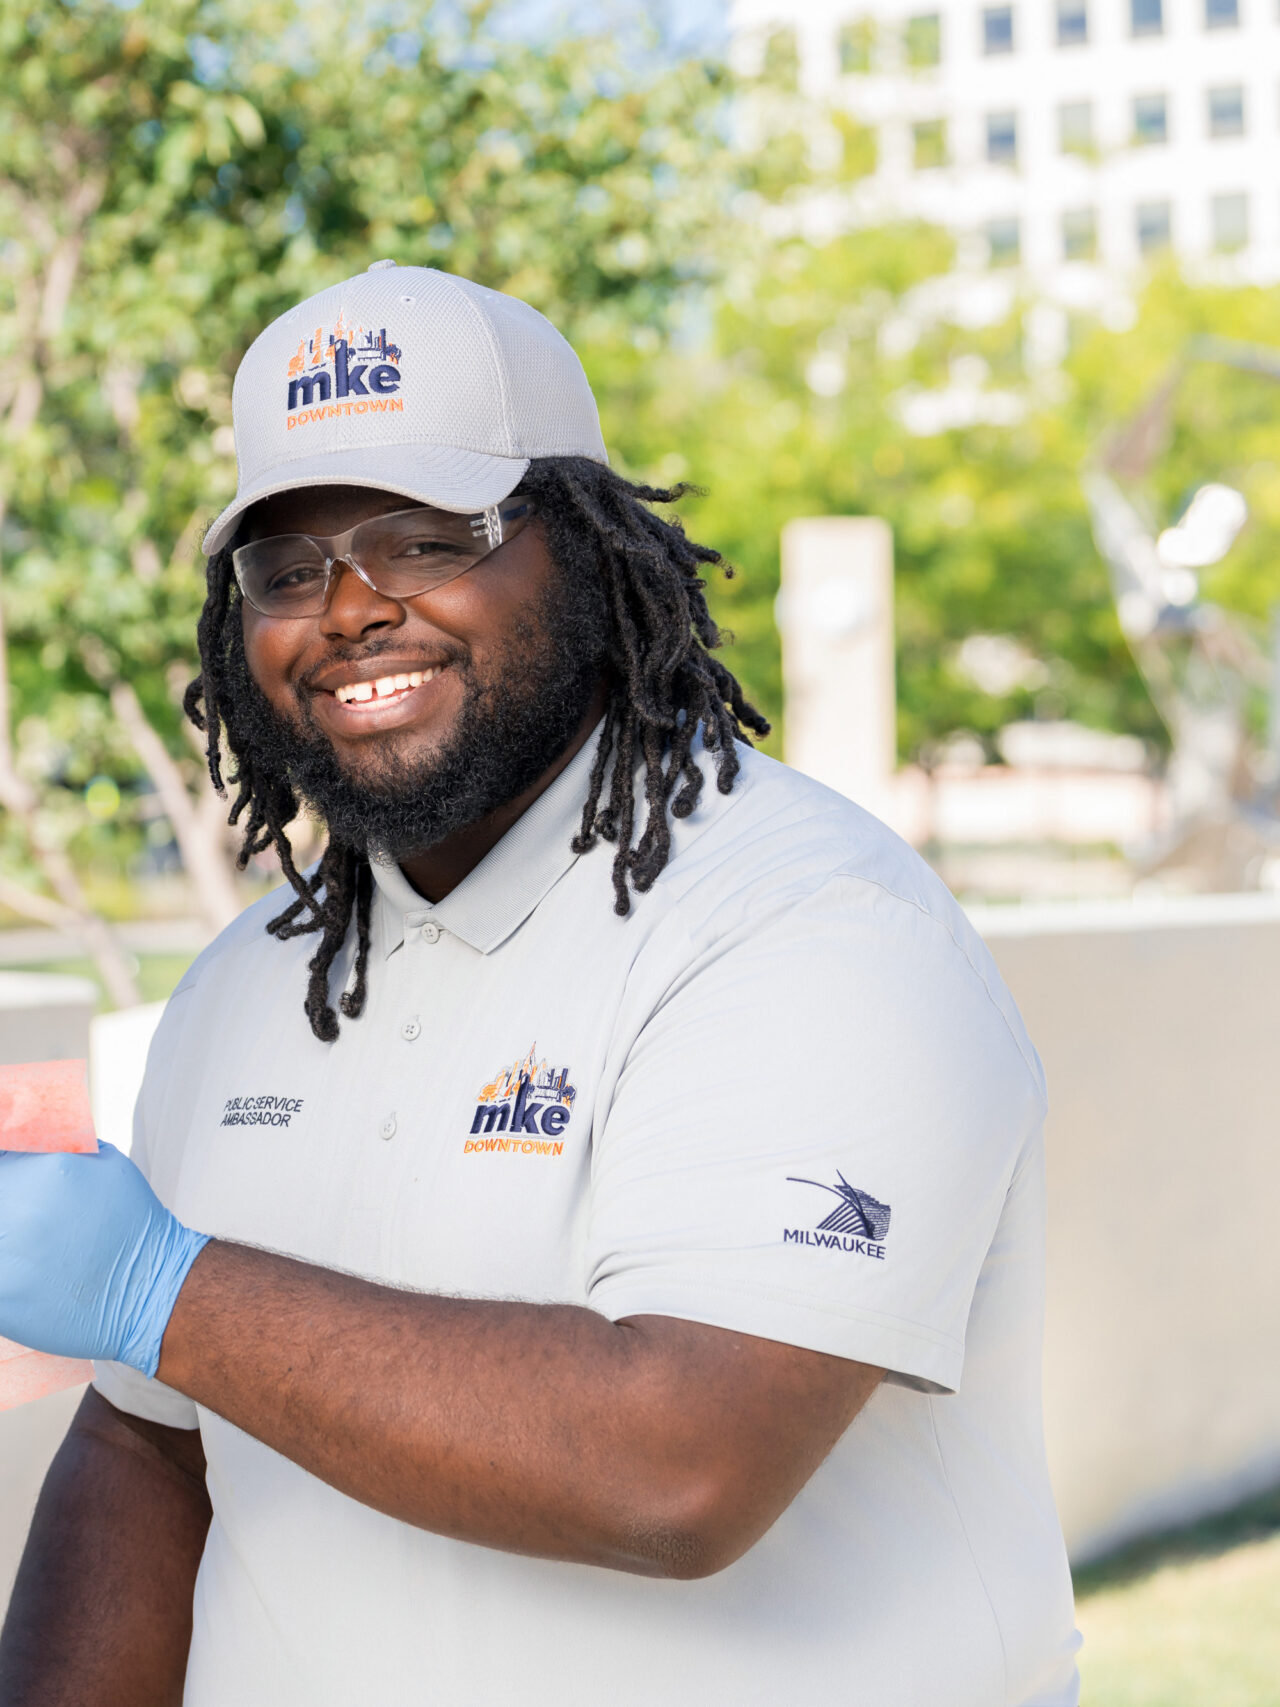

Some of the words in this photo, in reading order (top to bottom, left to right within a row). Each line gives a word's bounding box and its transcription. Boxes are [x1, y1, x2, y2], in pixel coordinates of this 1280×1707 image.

[287, 338, 402, 411] mke
[286, 398, 404, 431] DOWNTOWN
[224, 1096, 255, 1112] PUBLIC
[253, 1096, 304, 1112] SERVICE
[469, 1068, 570, 1136] mke
[220, 1111, 291, 1127] AMBASSADOR
[464, 1138, 564, 1156] DOWNTOWN
[783, 1228, 886, 1261] MILWAUKEE
